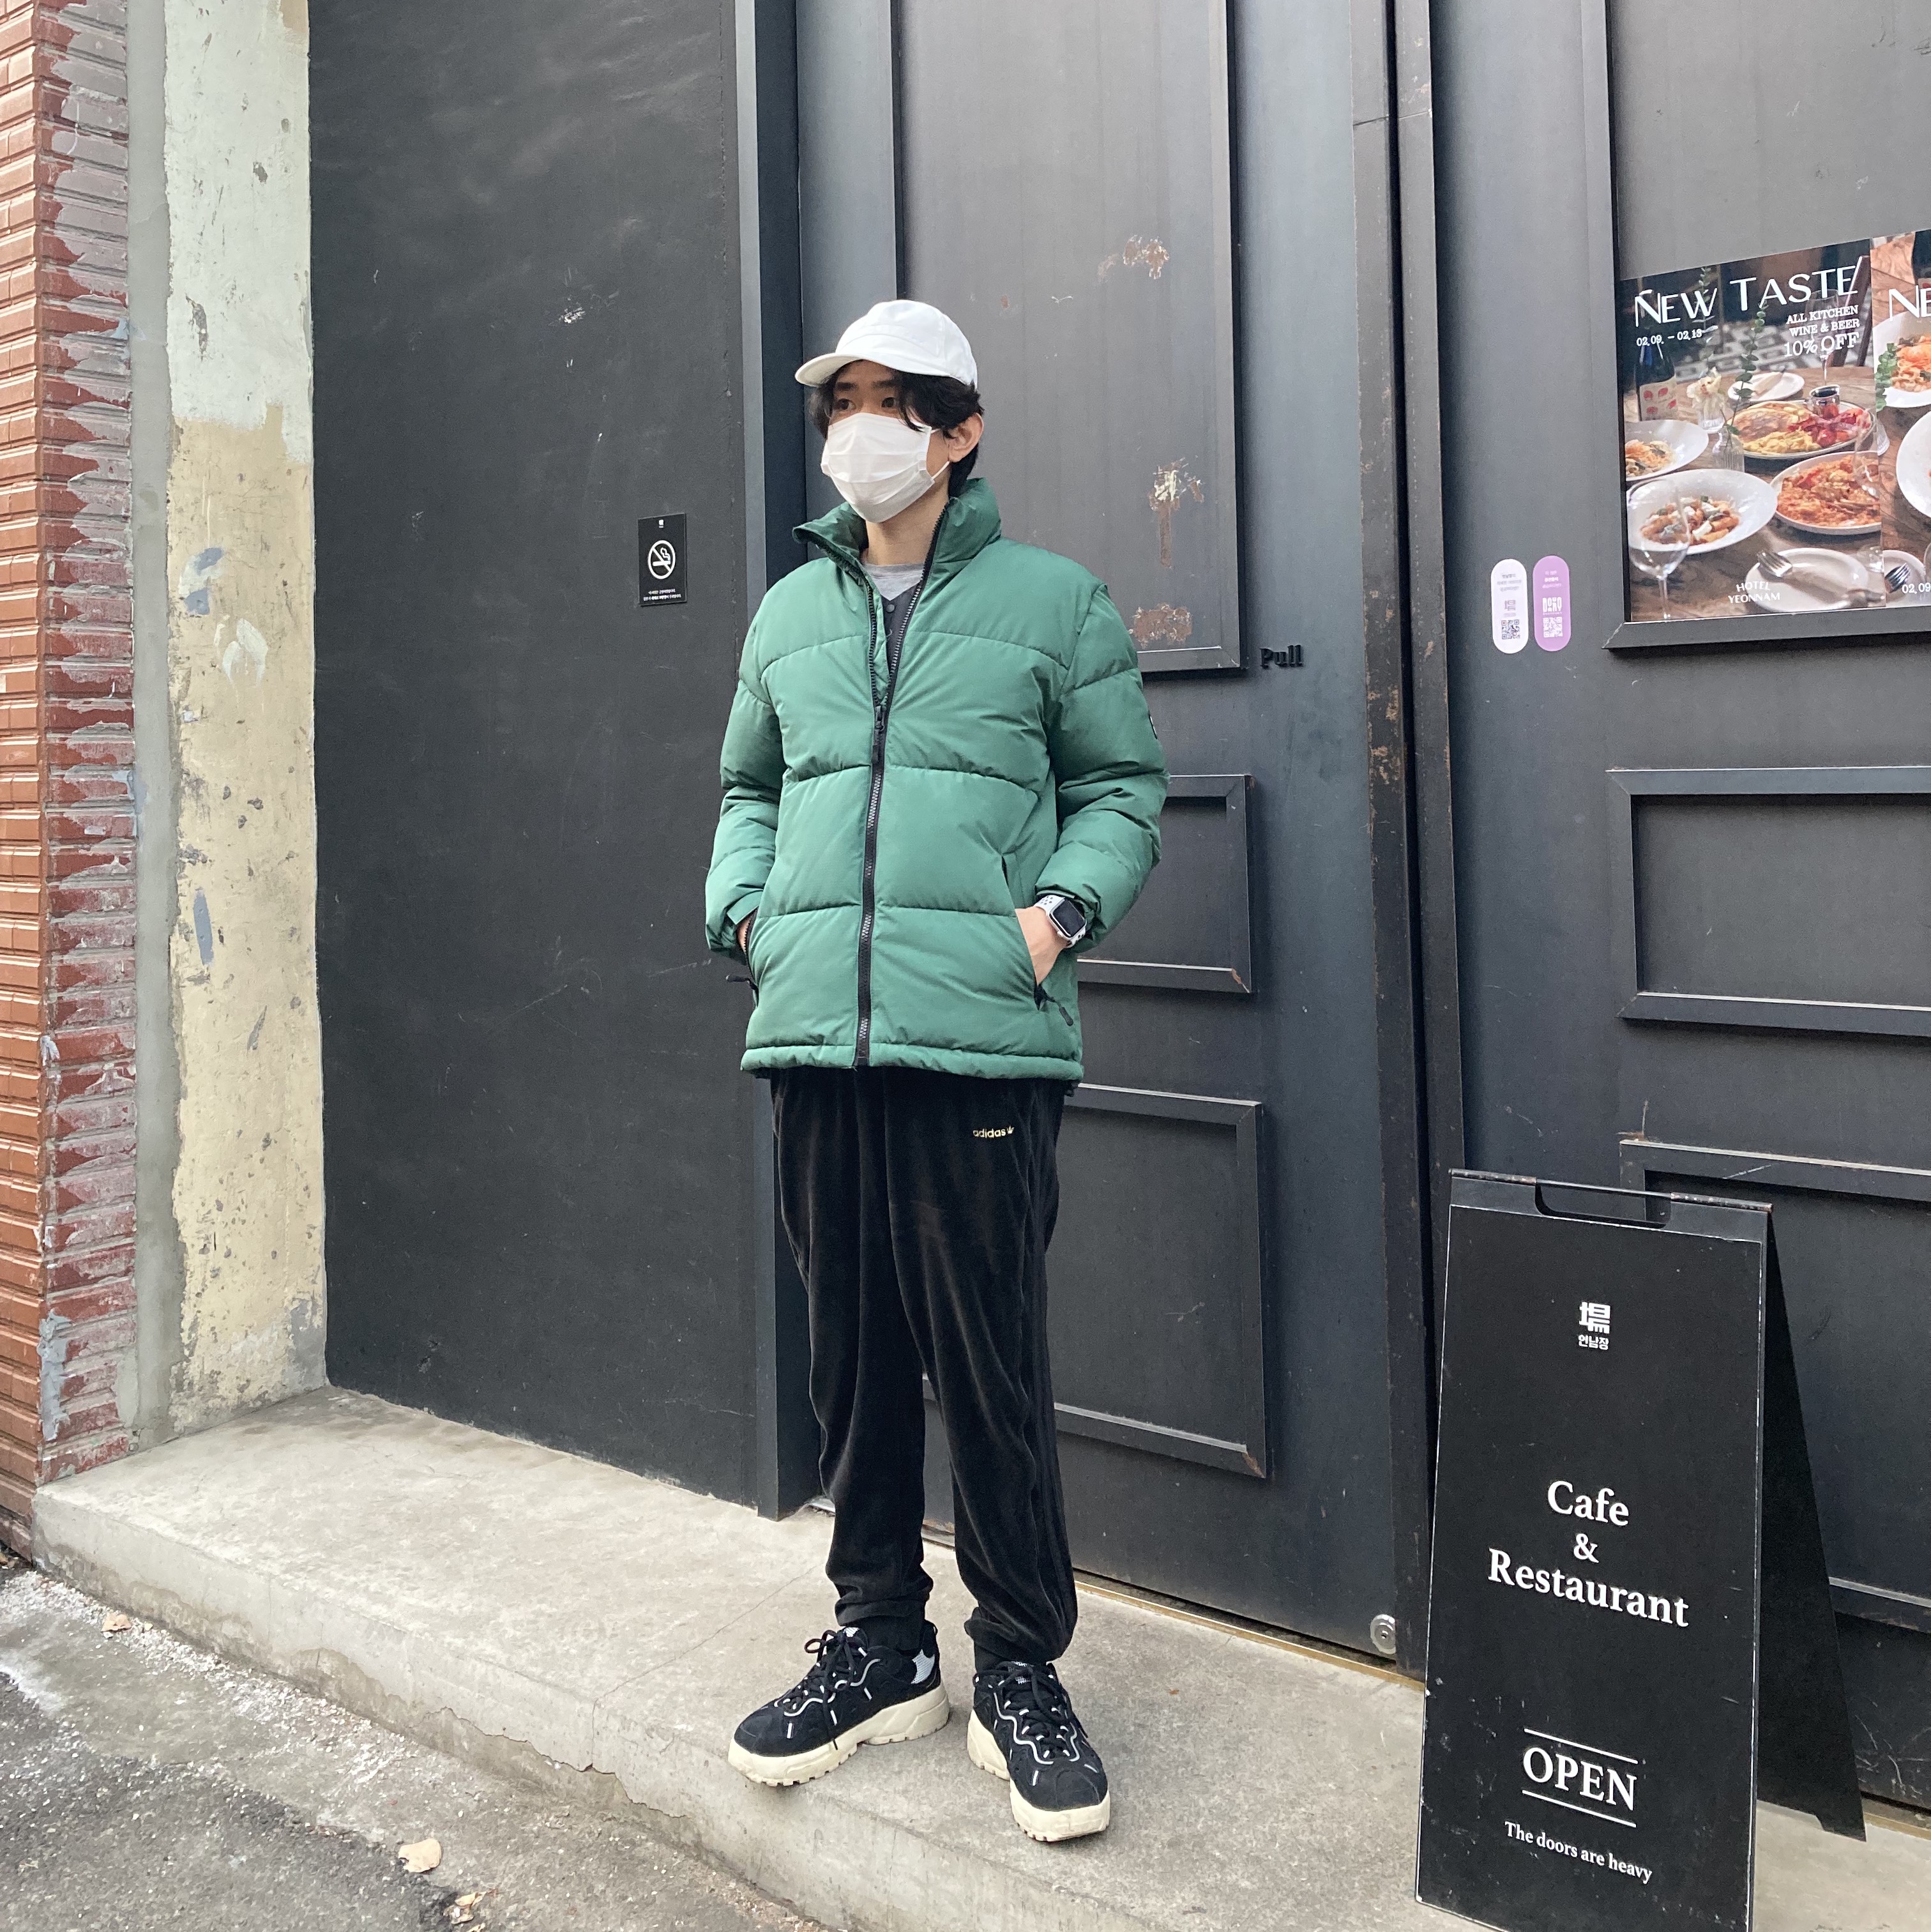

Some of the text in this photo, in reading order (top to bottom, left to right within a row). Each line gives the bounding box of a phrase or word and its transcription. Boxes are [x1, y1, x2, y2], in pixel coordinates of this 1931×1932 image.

[1635, 265, 1858, 327] NEW TASTE
[1785, 305, 1859, 324] ALL KITCHEN
[1789, 318, 1860, 337] WINE & BEER
[1636, 334, 1665, 346] 02.09.
[1783, 332, 1860, 358] 10% OFF
[1727, 592, 1780, 604] YEONNAM
[1736, 581, 1771, 593] HOTEL
[1260, 644, 1303, 670] Pull
[973, 1128, 1006, 1138] adidas
[1547, 1480, 1629, 1526] Cafe
[1573, 1533, 1600, 1563] &
[1488, 1547, 1689, 1627] Restaurant
[1523, 1747, 1637, 1811] OPEN
[1504, 1821, 1653, 1885] The doors are heavy
